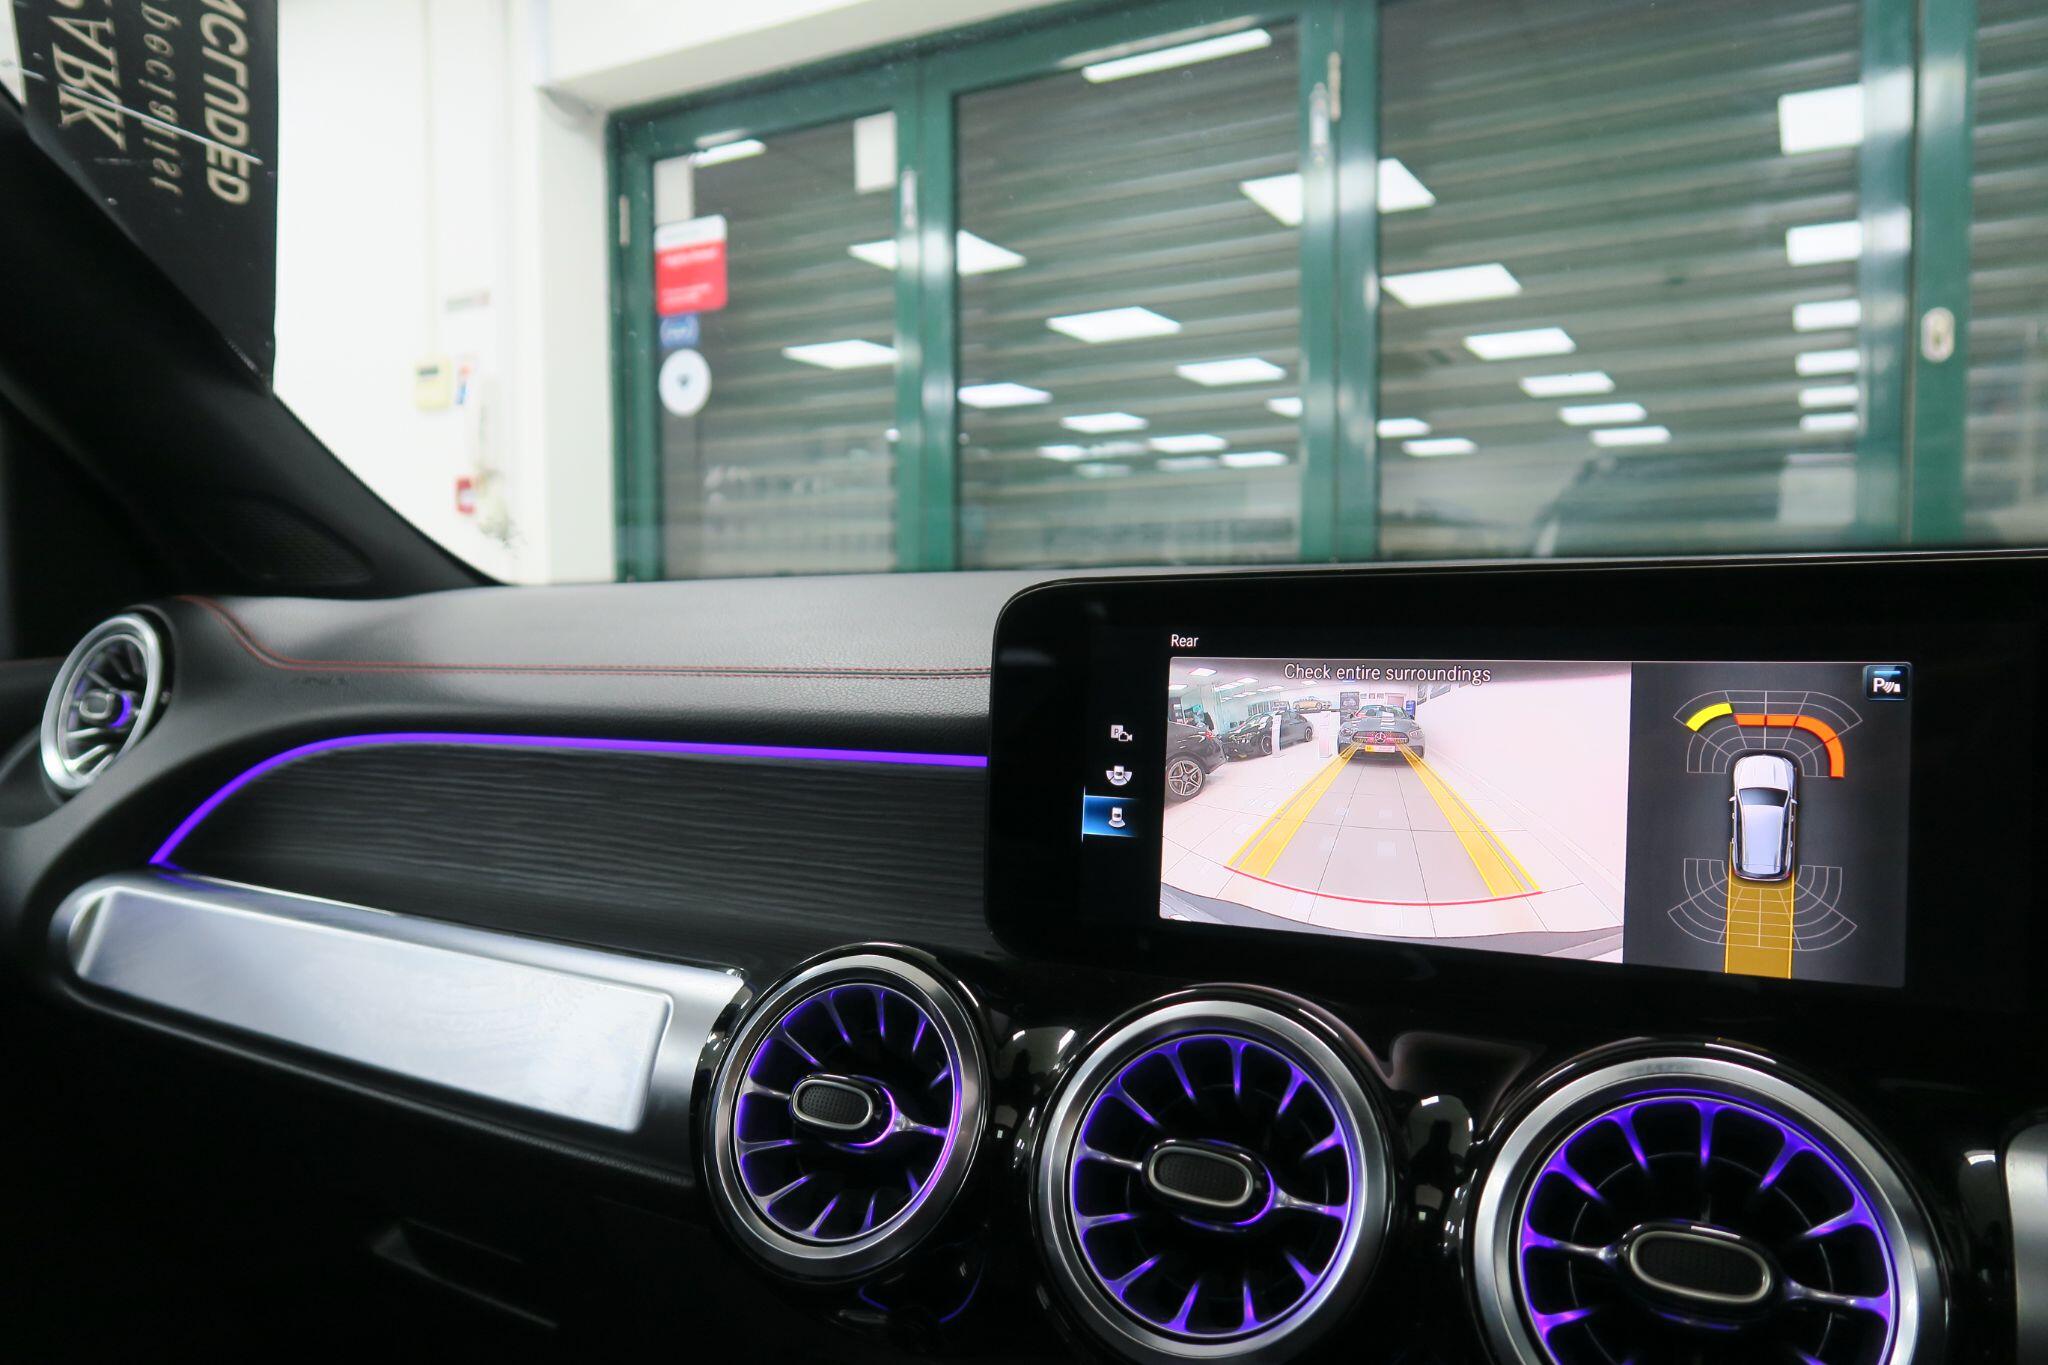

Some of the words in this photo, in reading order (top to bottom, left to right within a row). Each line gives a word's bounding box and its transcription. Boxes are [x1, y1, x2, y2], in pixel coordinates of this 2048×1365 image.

[1170, 634, 1199, 648] Rear
[1284, 663, 1331, 679] Check
[1336, 665, 1381, 680] entire
[1385, 666, 1491, 685] surroundings
